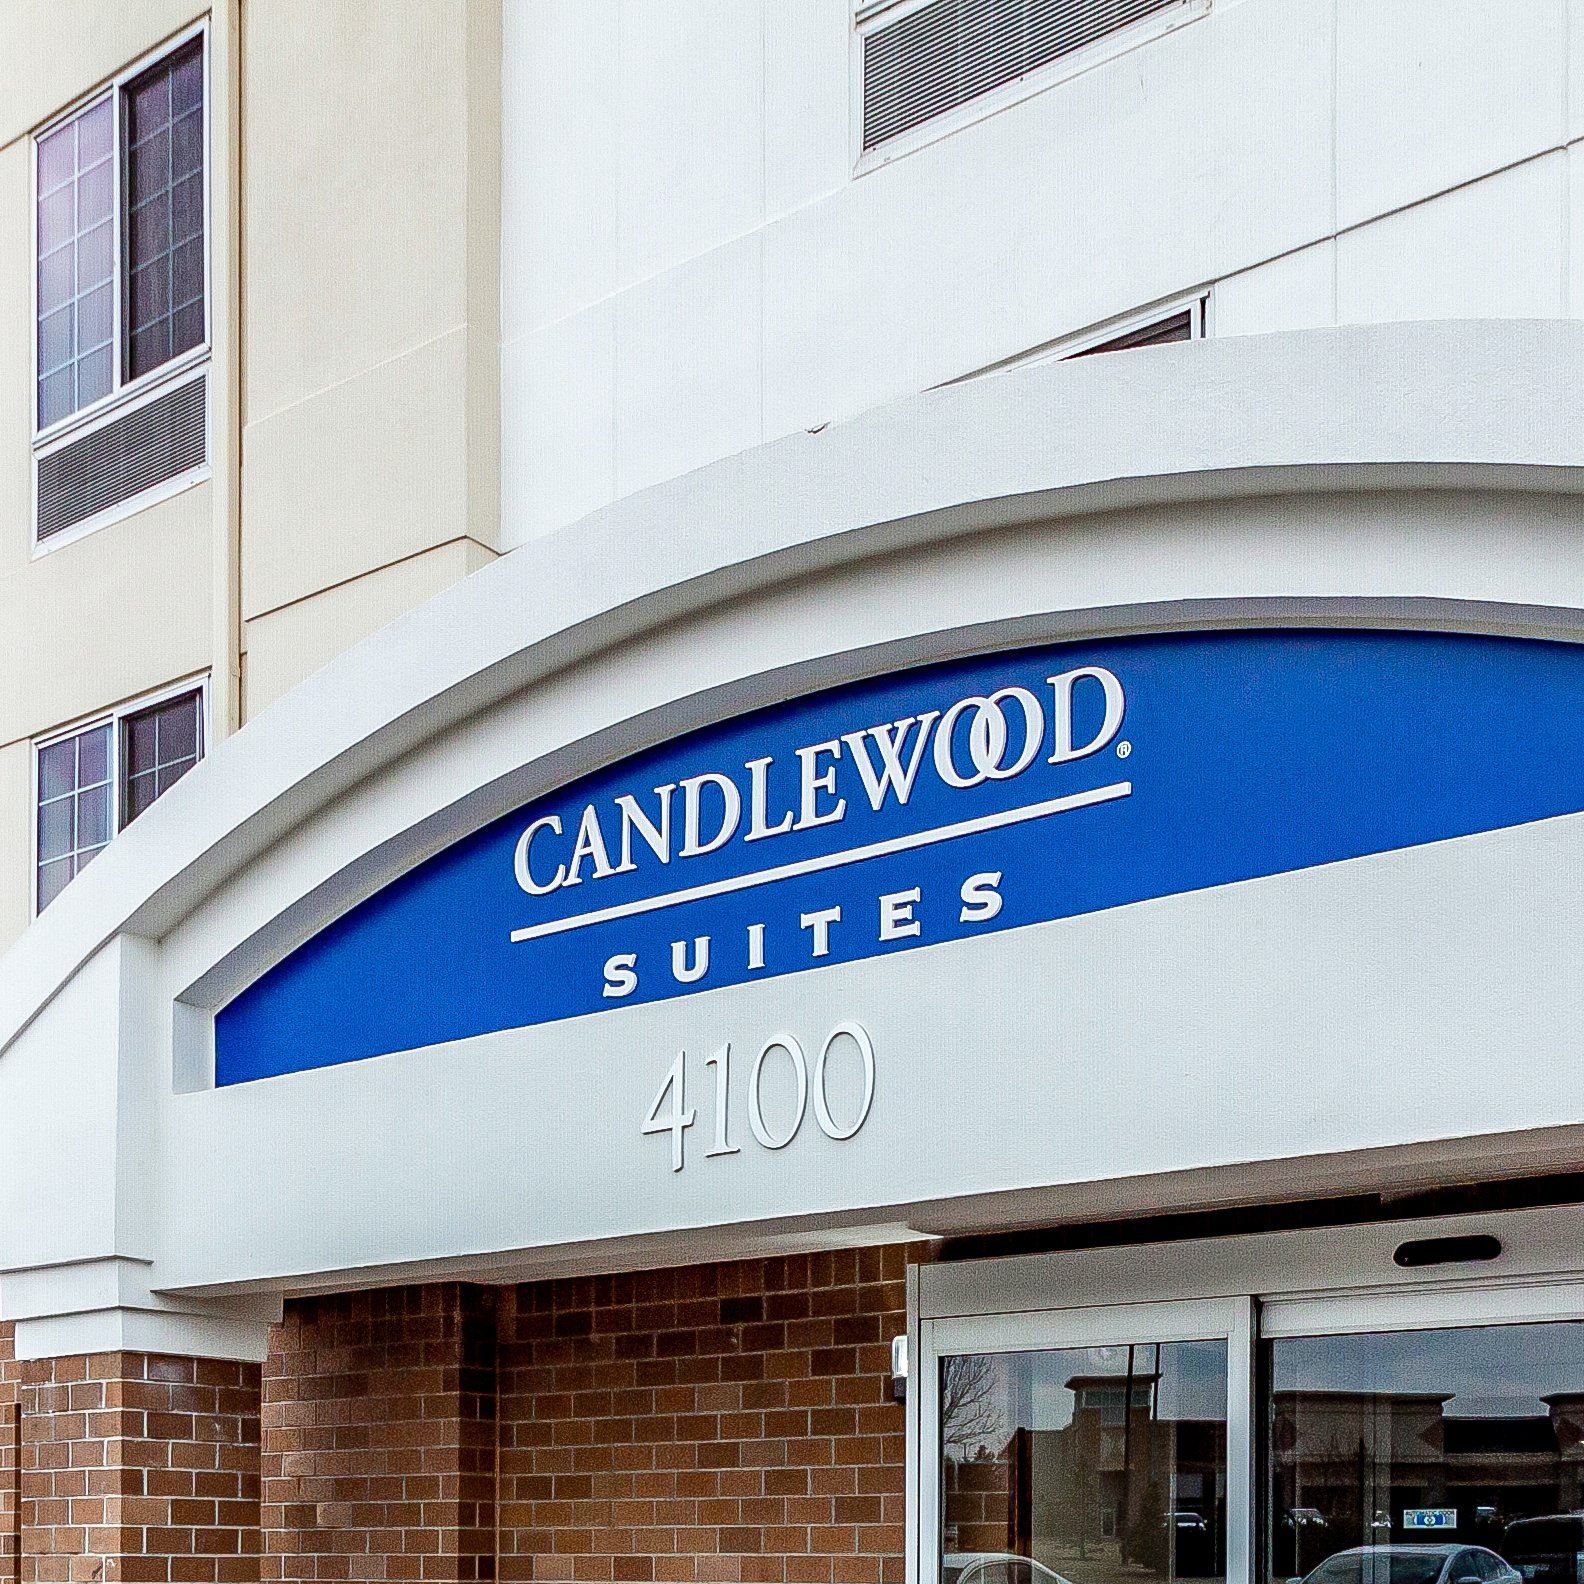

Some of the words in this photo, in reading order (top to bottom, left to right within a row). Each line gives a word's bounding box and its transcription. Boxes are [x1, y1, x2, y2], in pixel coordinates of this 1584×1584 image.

[512, 666, 1126, 896] CANDLEWOOD
[602, 870, 1003, 998] SUITES
[640, 1020, 876, 1172] 4100
